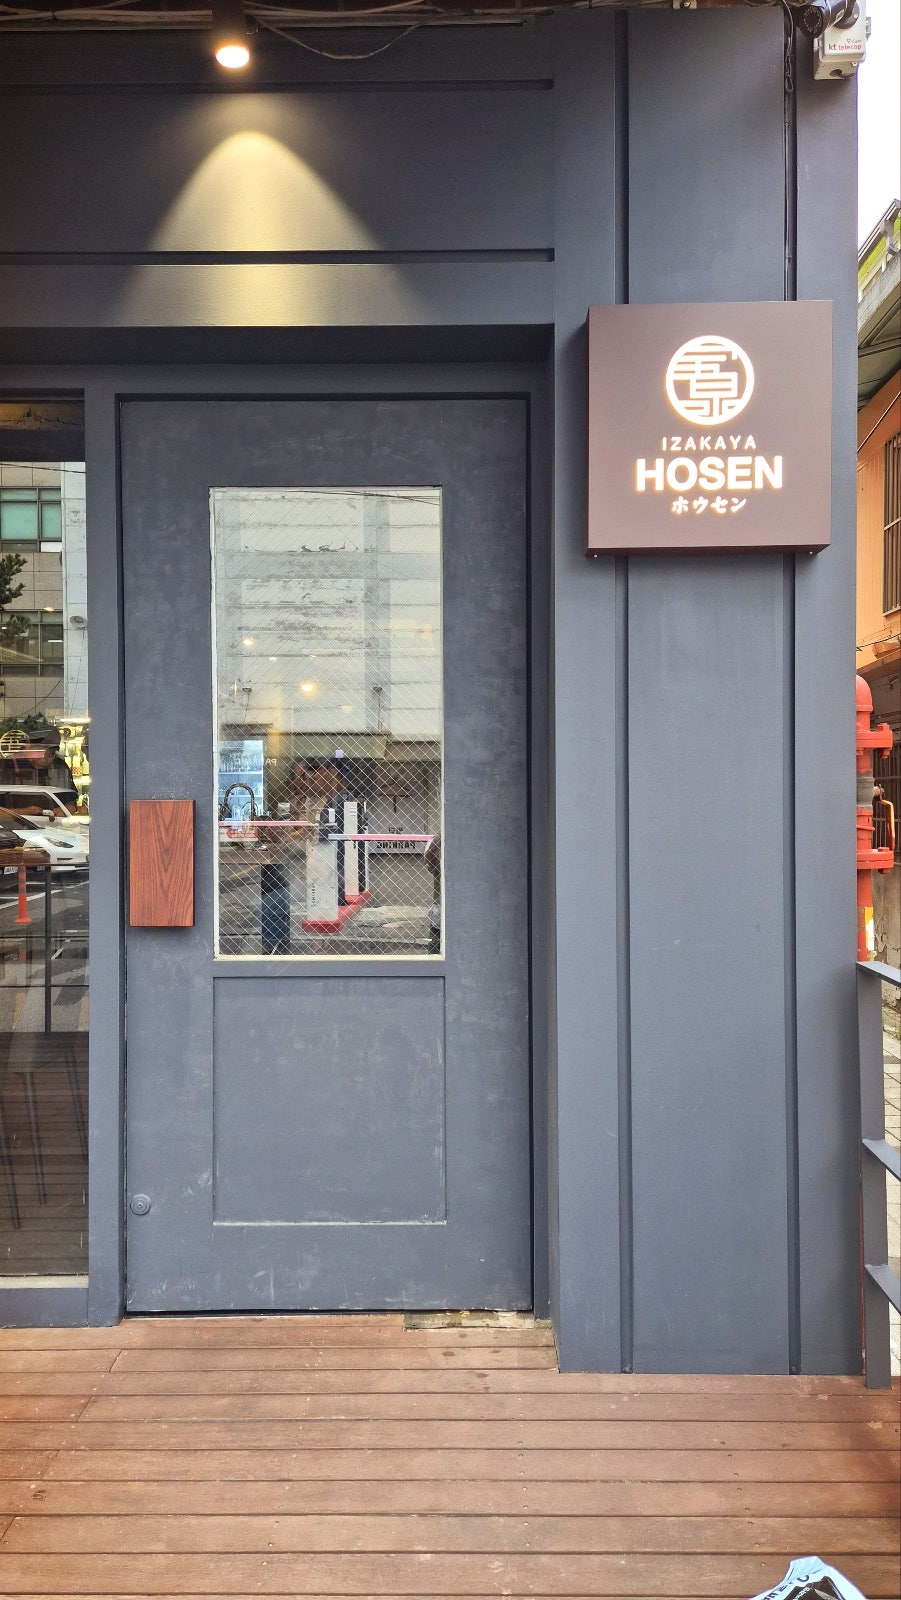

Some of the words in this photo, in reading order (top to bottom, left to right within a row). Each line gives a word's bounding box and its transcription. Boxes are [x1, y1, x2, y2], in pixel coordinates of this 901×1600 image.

[828, 43, 838, 51] kt
[838, 43, 862, 51] telecop
[662, 435, 757, 451] IZAKAYA
[635, 455, 783, 492] HOSEN
[671, 496, 747, 515] ホウセン
